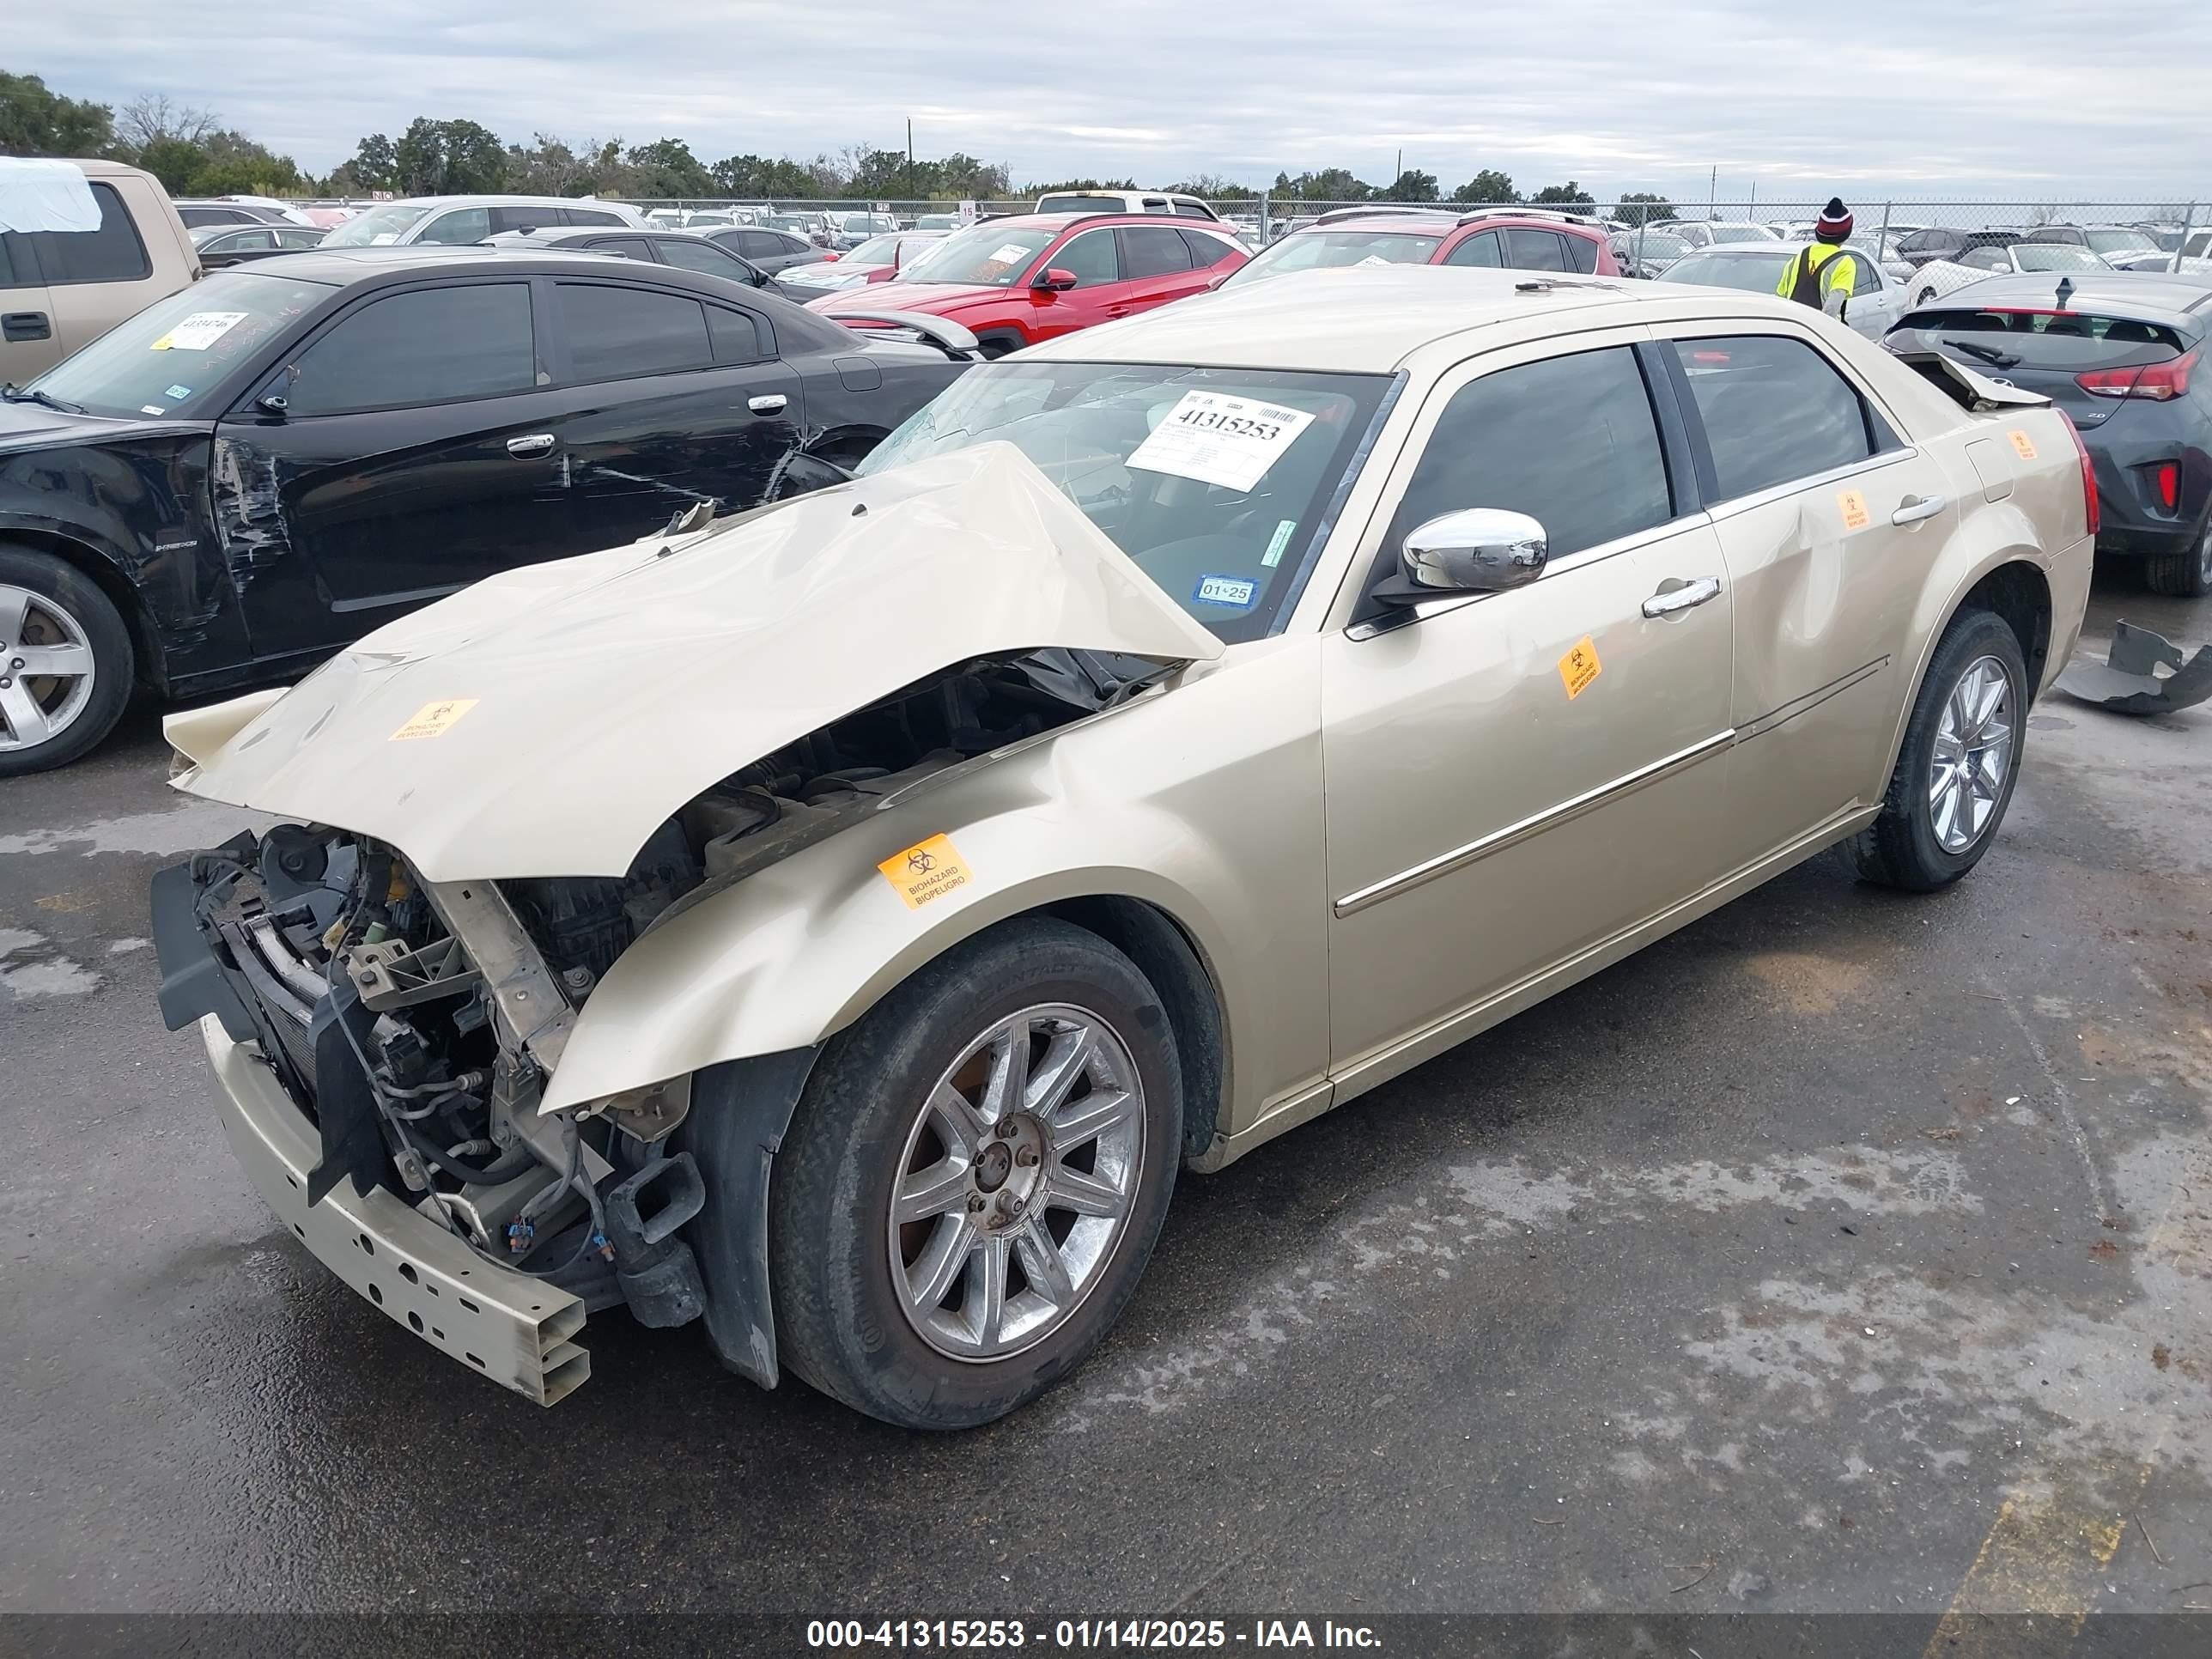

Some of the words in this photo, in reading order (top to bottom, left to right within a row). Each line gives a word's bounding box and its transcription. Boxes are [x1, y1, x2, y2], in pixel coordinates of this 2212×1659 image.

[963, 207, 973, 216] 15
[1179, 410, 1280, 441] 41315253
[1203, 584, 1220, 595] 01
[1229, 587, 1249, 599] 25
[908, 866, 958, 895] BIOHAZARD
[915, 876, 965, 905] BIOPELIGRO
